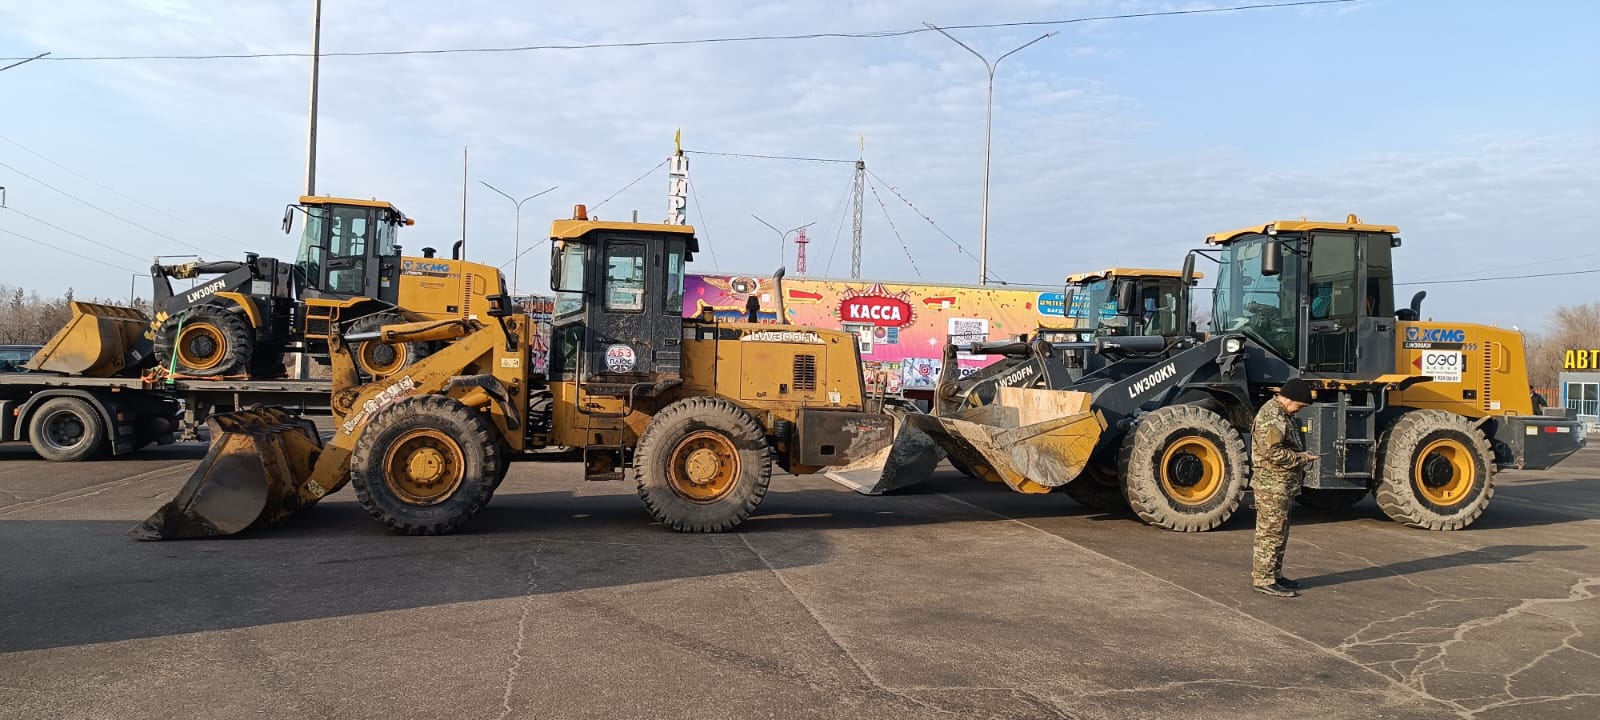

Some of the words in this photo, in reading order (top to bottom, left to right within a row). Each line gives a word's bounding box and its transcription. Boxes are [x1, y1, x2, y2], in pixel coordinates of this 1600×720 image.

[415, 261, 450, 272] XCMG
[187, 279, 226, 303] LW300FN
[850, 304, 901, 320] КАССА
[1422, 328, 1465, 342] XCMG
[608, 349, 632, 357] АБЗ
[1564, 350, 1600, 369] АВТ
[995, 365, 1033, 390] LW300FN
[1128, 362, 1176, 399] LW300KN
